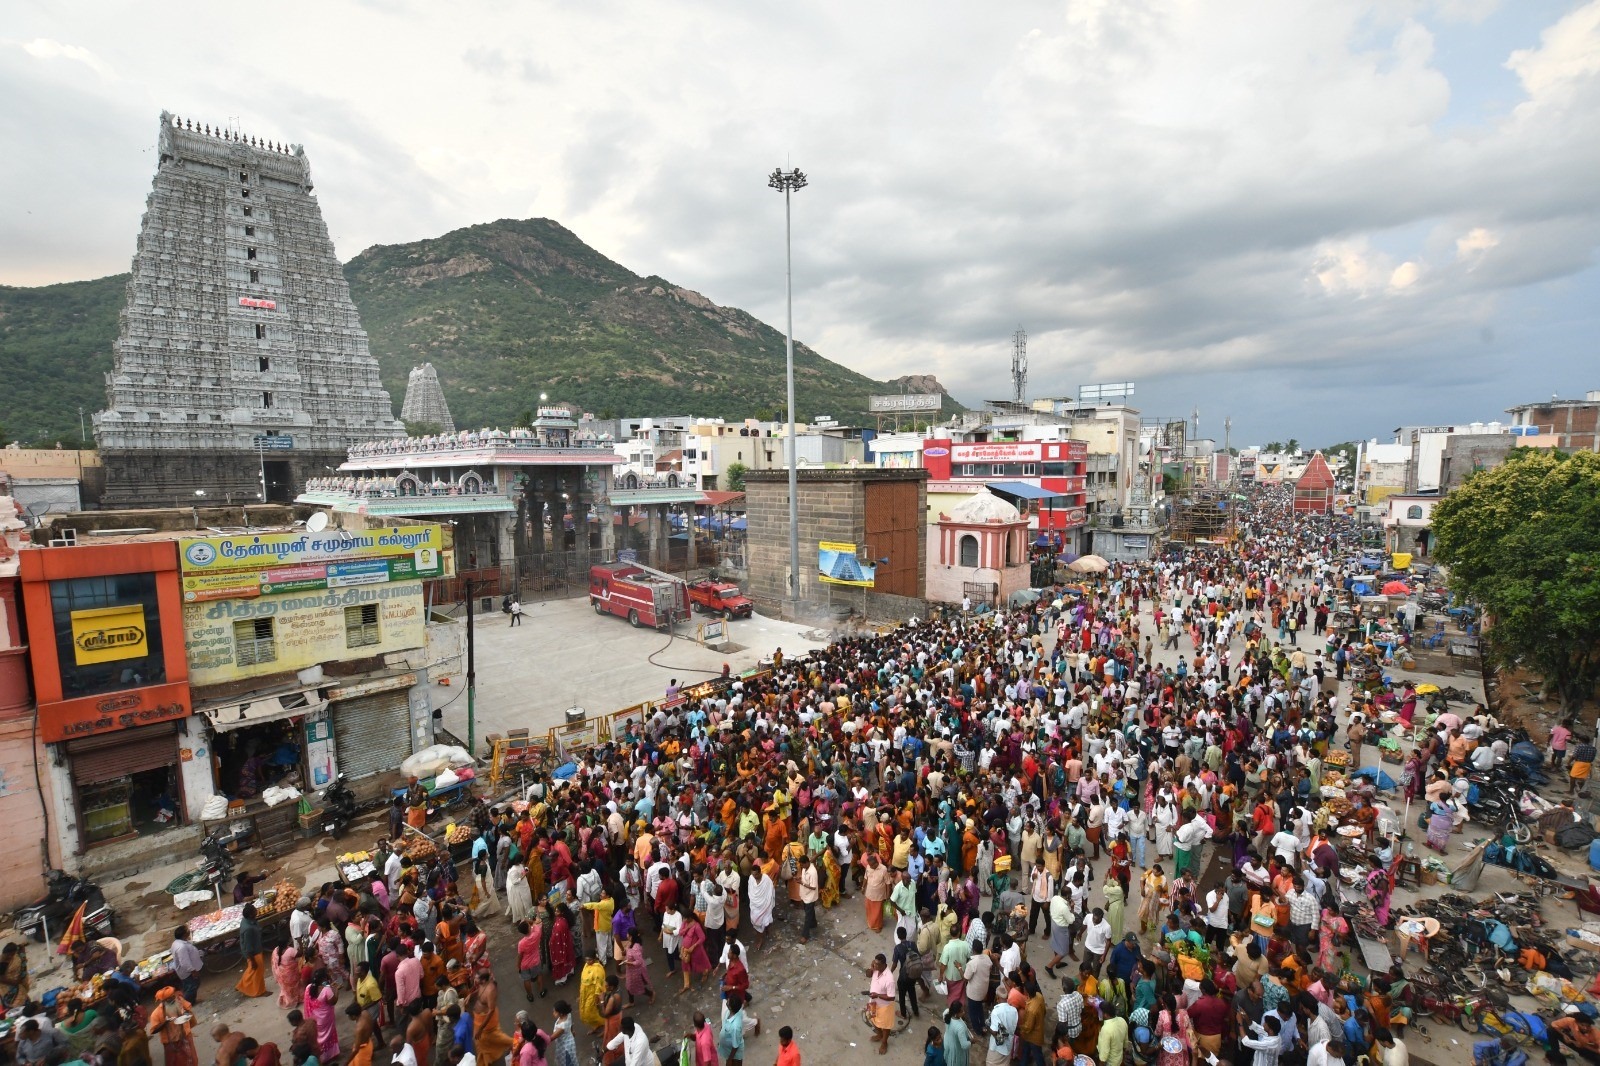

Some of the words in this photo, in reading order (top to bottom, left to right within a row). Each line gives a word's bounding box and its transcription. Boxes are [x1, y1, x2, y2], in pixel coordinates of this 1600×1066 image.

[874, 395, 936, 409] சக்ரவர்த்தி
[220, 536, 309, 560] தேன்பழனி
[311, 535, 374, 553] சமுதாய
[378, 528, 432, 549] கல்லூரி
[205, 600, 279, 620] சித்த
[279, 612, 313, 624] குழந்தை
[193, 625, 225, 639] மூன்று
